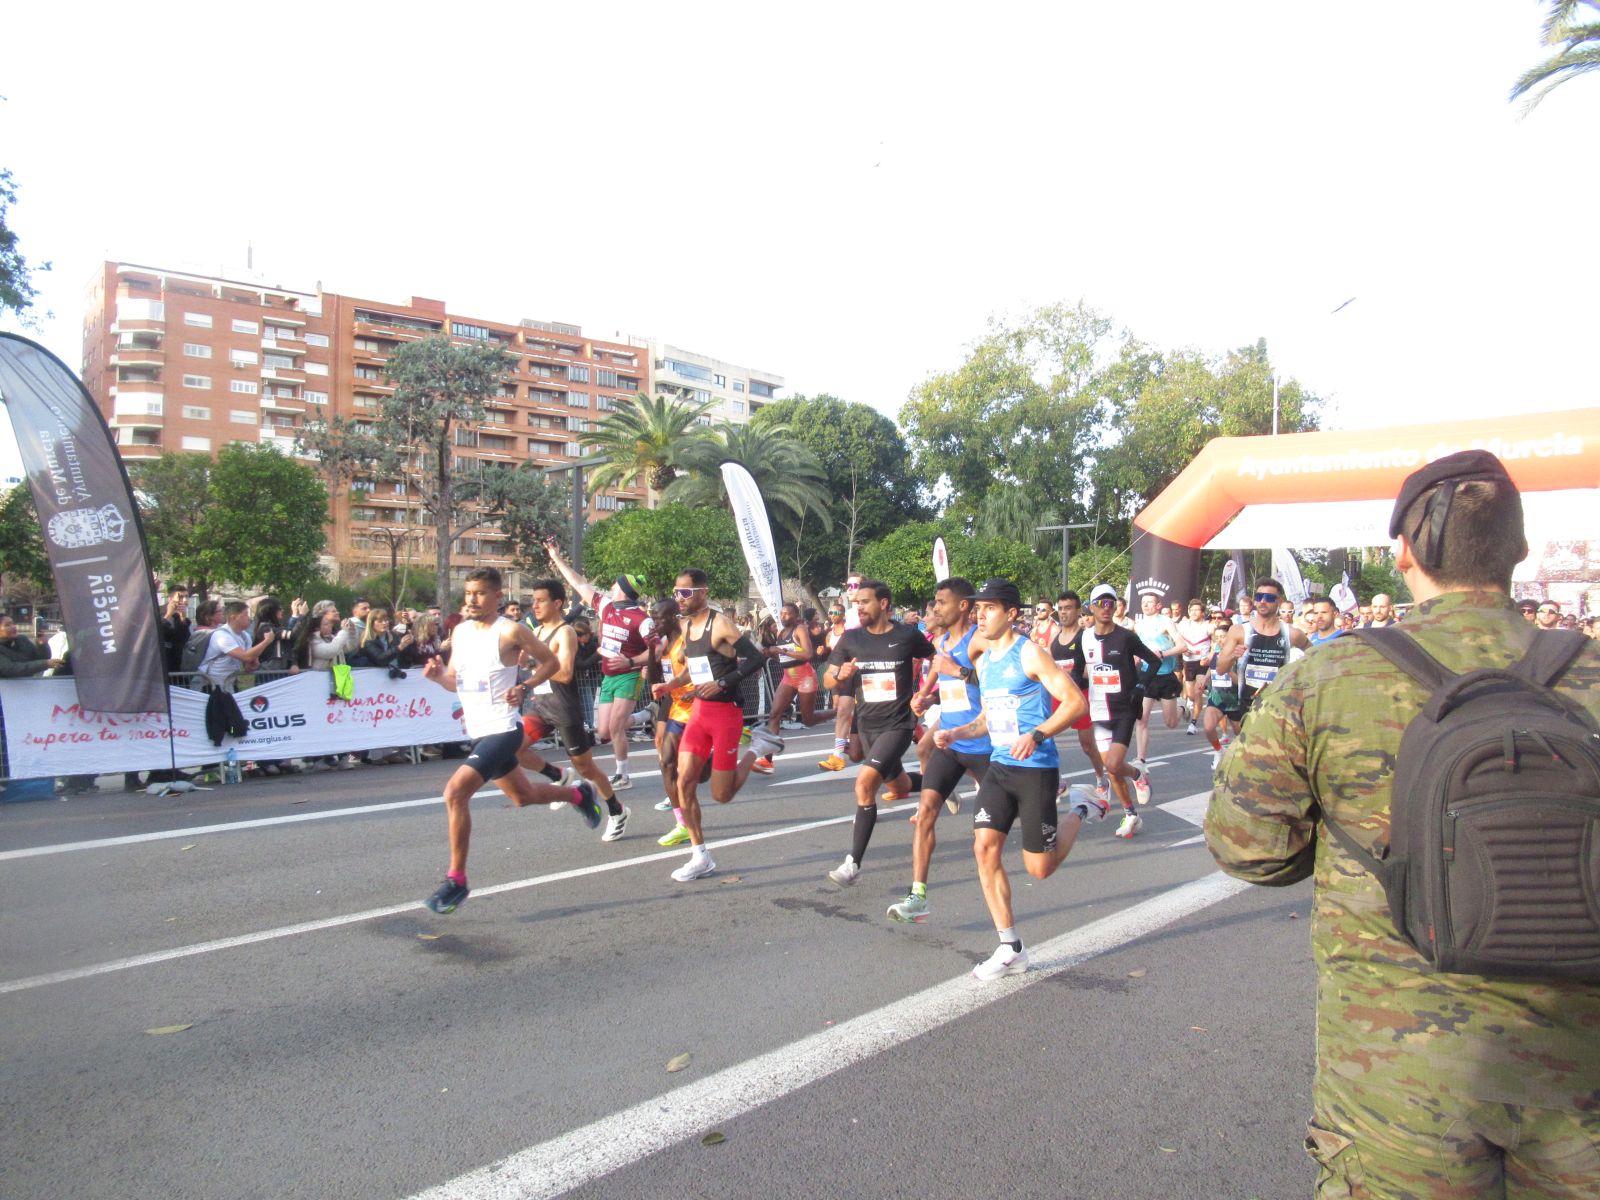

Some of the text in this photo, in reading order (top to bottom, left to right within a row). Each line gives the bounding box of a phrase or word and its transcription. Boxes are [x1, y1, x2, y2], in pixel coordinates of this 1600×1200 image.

[1237, 447, 1420, 480] Ayuntamiento
[243, 713, 306, 730] GIUS
[99, 727, 120, 741] tu
